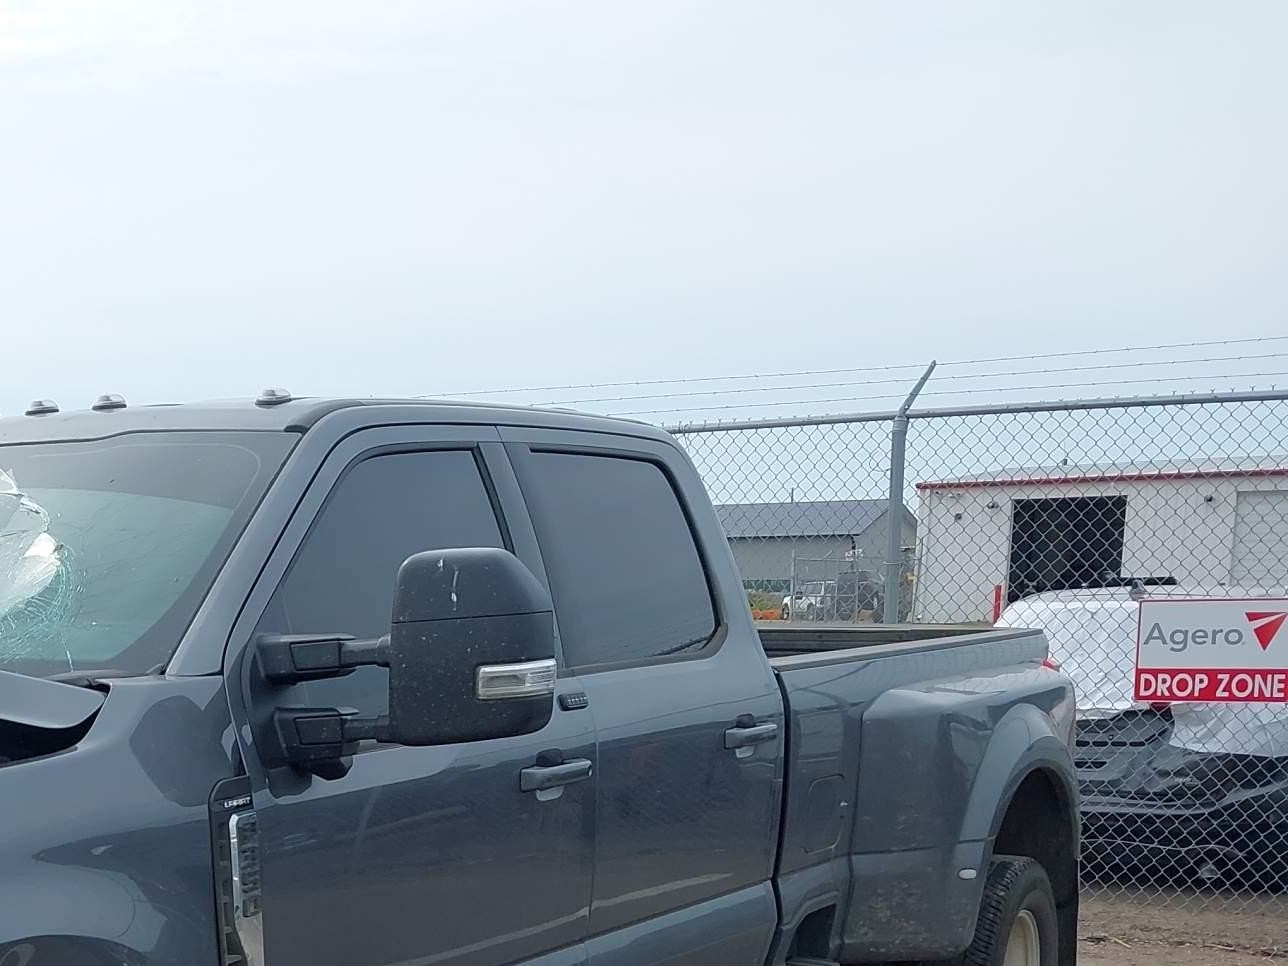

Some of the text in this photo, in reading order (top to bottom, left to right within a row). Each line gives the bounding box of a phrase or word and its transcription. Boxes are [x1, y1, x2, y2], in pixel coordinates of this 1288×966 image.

[1143, 622, 1244, 653] Agero
[1139, 673, 1287, 698] DROP ZONE
